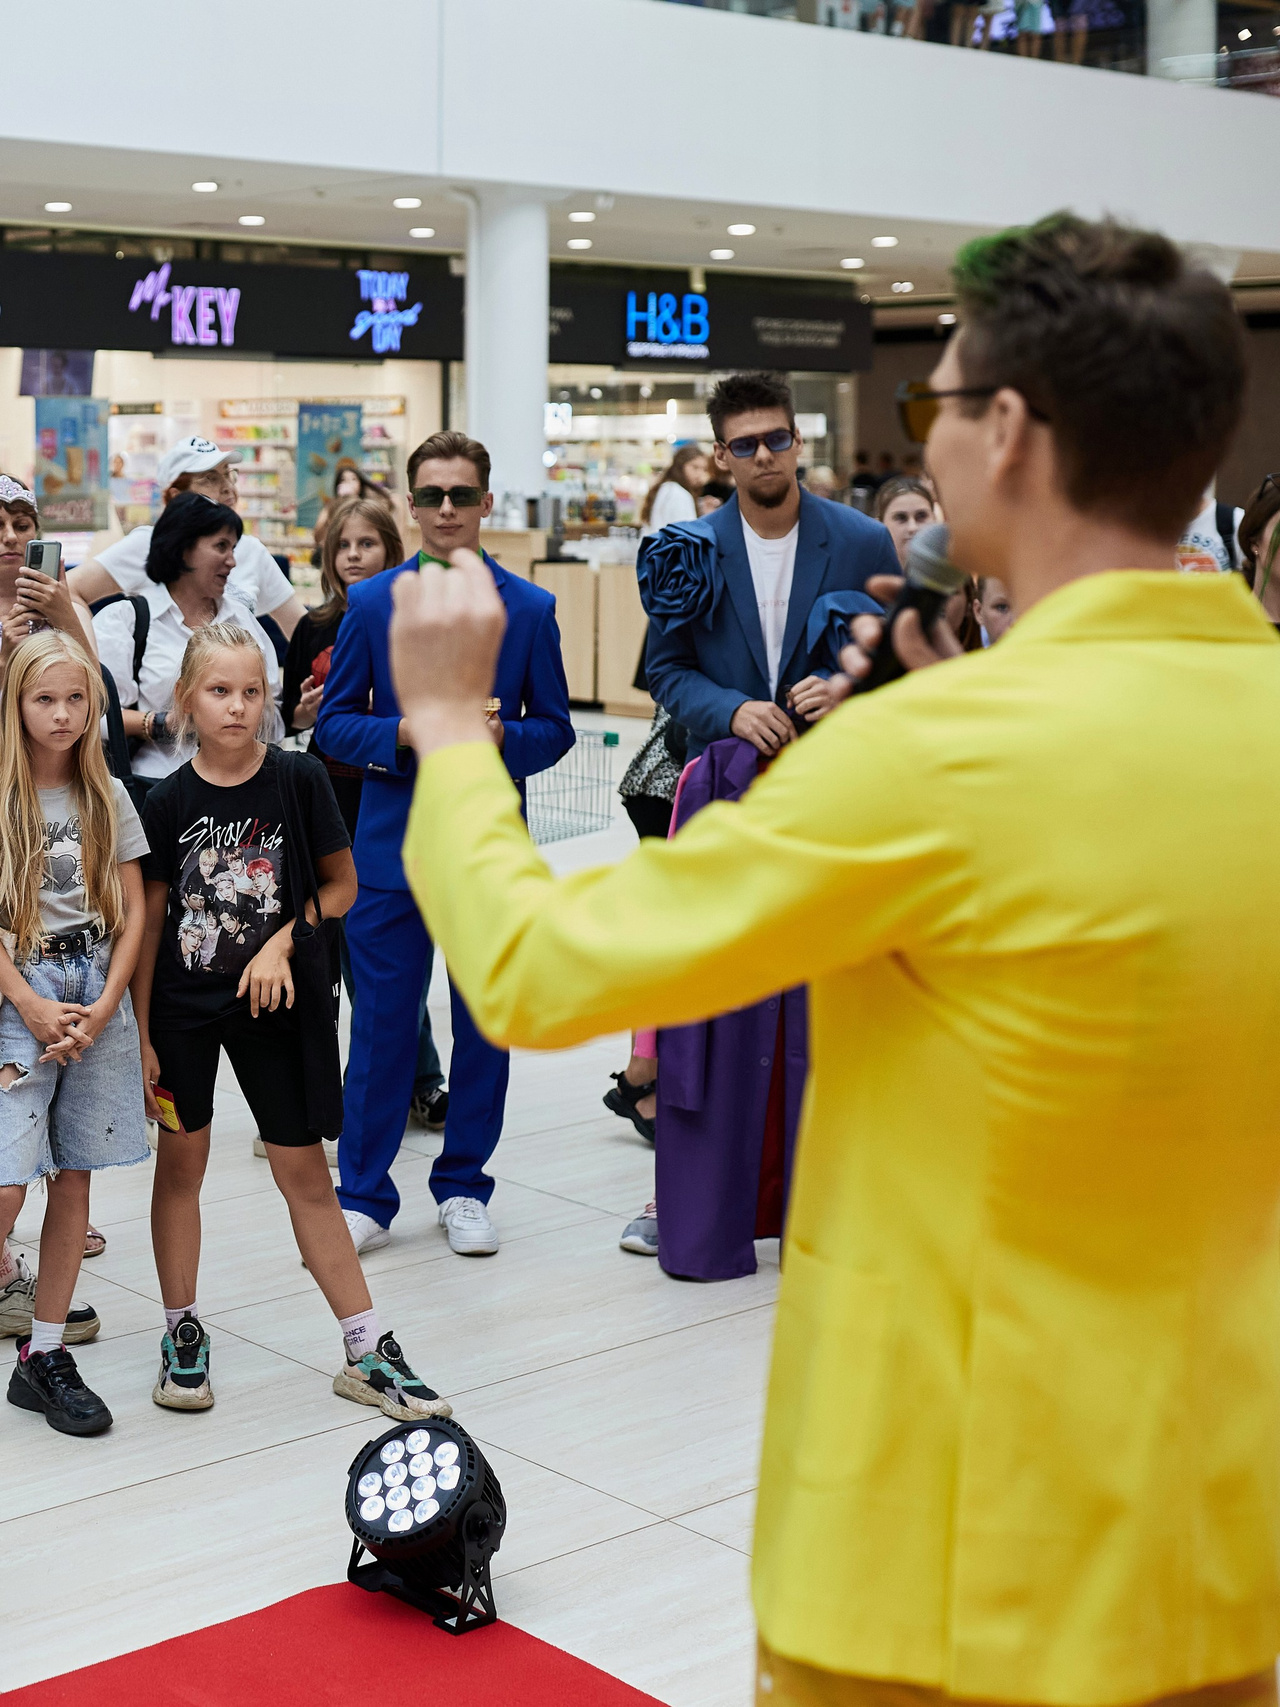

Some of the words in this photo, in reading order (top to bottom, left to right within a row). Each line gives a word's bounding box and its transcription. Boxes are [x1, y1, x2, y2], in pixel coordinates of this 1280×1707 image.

[171, 285, 241, 347] KEY
[626, 290, 710, 344] H&B
[179, 816, 252, 869] Stray
[344, 1326, 366, 1338] ANCE
